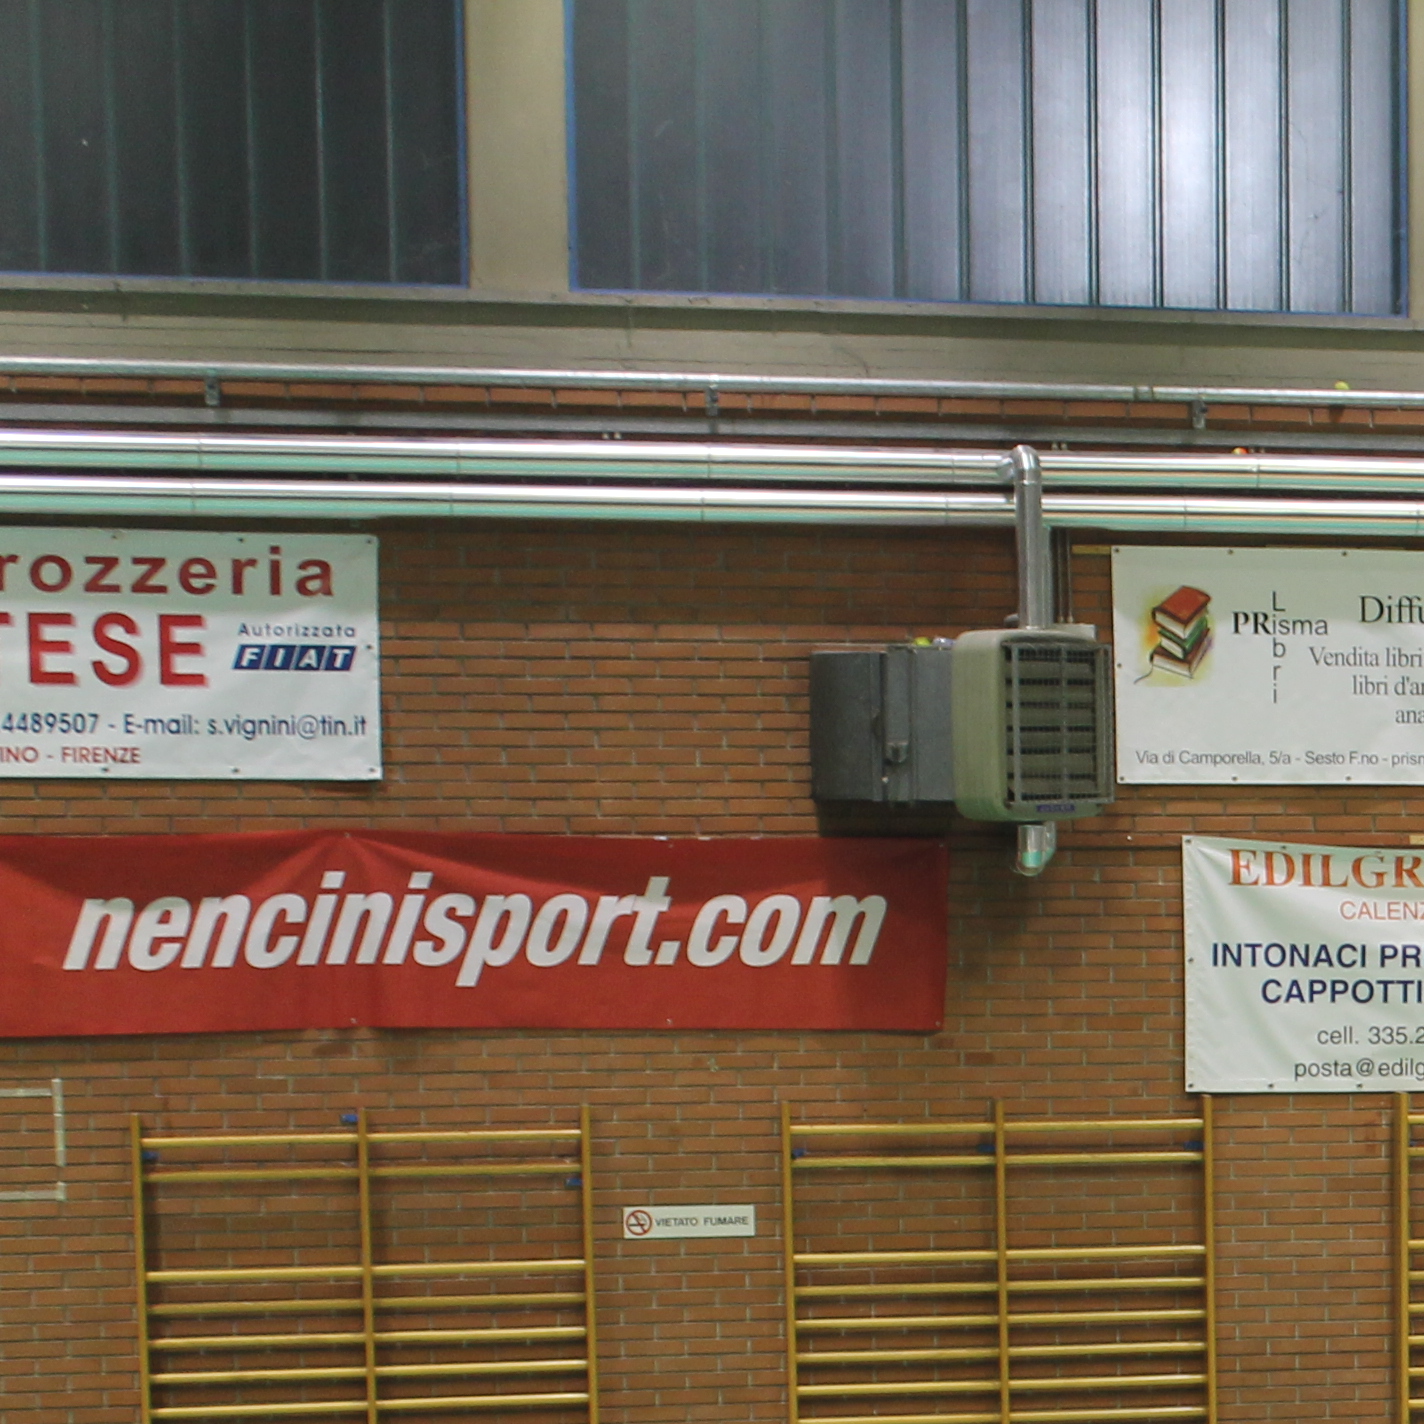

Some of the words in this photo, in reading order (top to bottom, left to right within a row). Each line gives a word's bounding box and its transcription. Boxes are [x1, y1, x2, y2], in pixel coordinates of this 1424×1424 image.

[238, 622, 356, 638] Autorizzata
[0, 611, 209, 688] ESE
[237, 646, 353, 669] FIAT
[1309, 647, 1380, 669] Vendita
[1386, 647, 1423, 669] libri
[1352, 676, 1389, 696] libri
[1, 712, 99, 734] 4489507
[123, 712, 201, 735] E-mail:
[207, 714, 367, 741] s.vignini@tin.it
[61, 746, 141, 764] FIRENZE
[1135, 750, 1159, 765] Via
[1162, 750, 1176, 765] di
[1268, 751, 1292, 765] 5/a
[1304, 750, 1345, 766] Sesto
[1349, 751, 1379, 766] F.no
[62, 871, 888, 987] nencinisport.com
[1211, 942, 1367, 969] INTONACI
[1261, 978, 1423, 1004] CAPPOTTI
[1316, 1025, 1359, 1045] cell.
[655, 1216, 698, 1227] VIETATO
[703, 1215, 749, 1226] FUMARE
